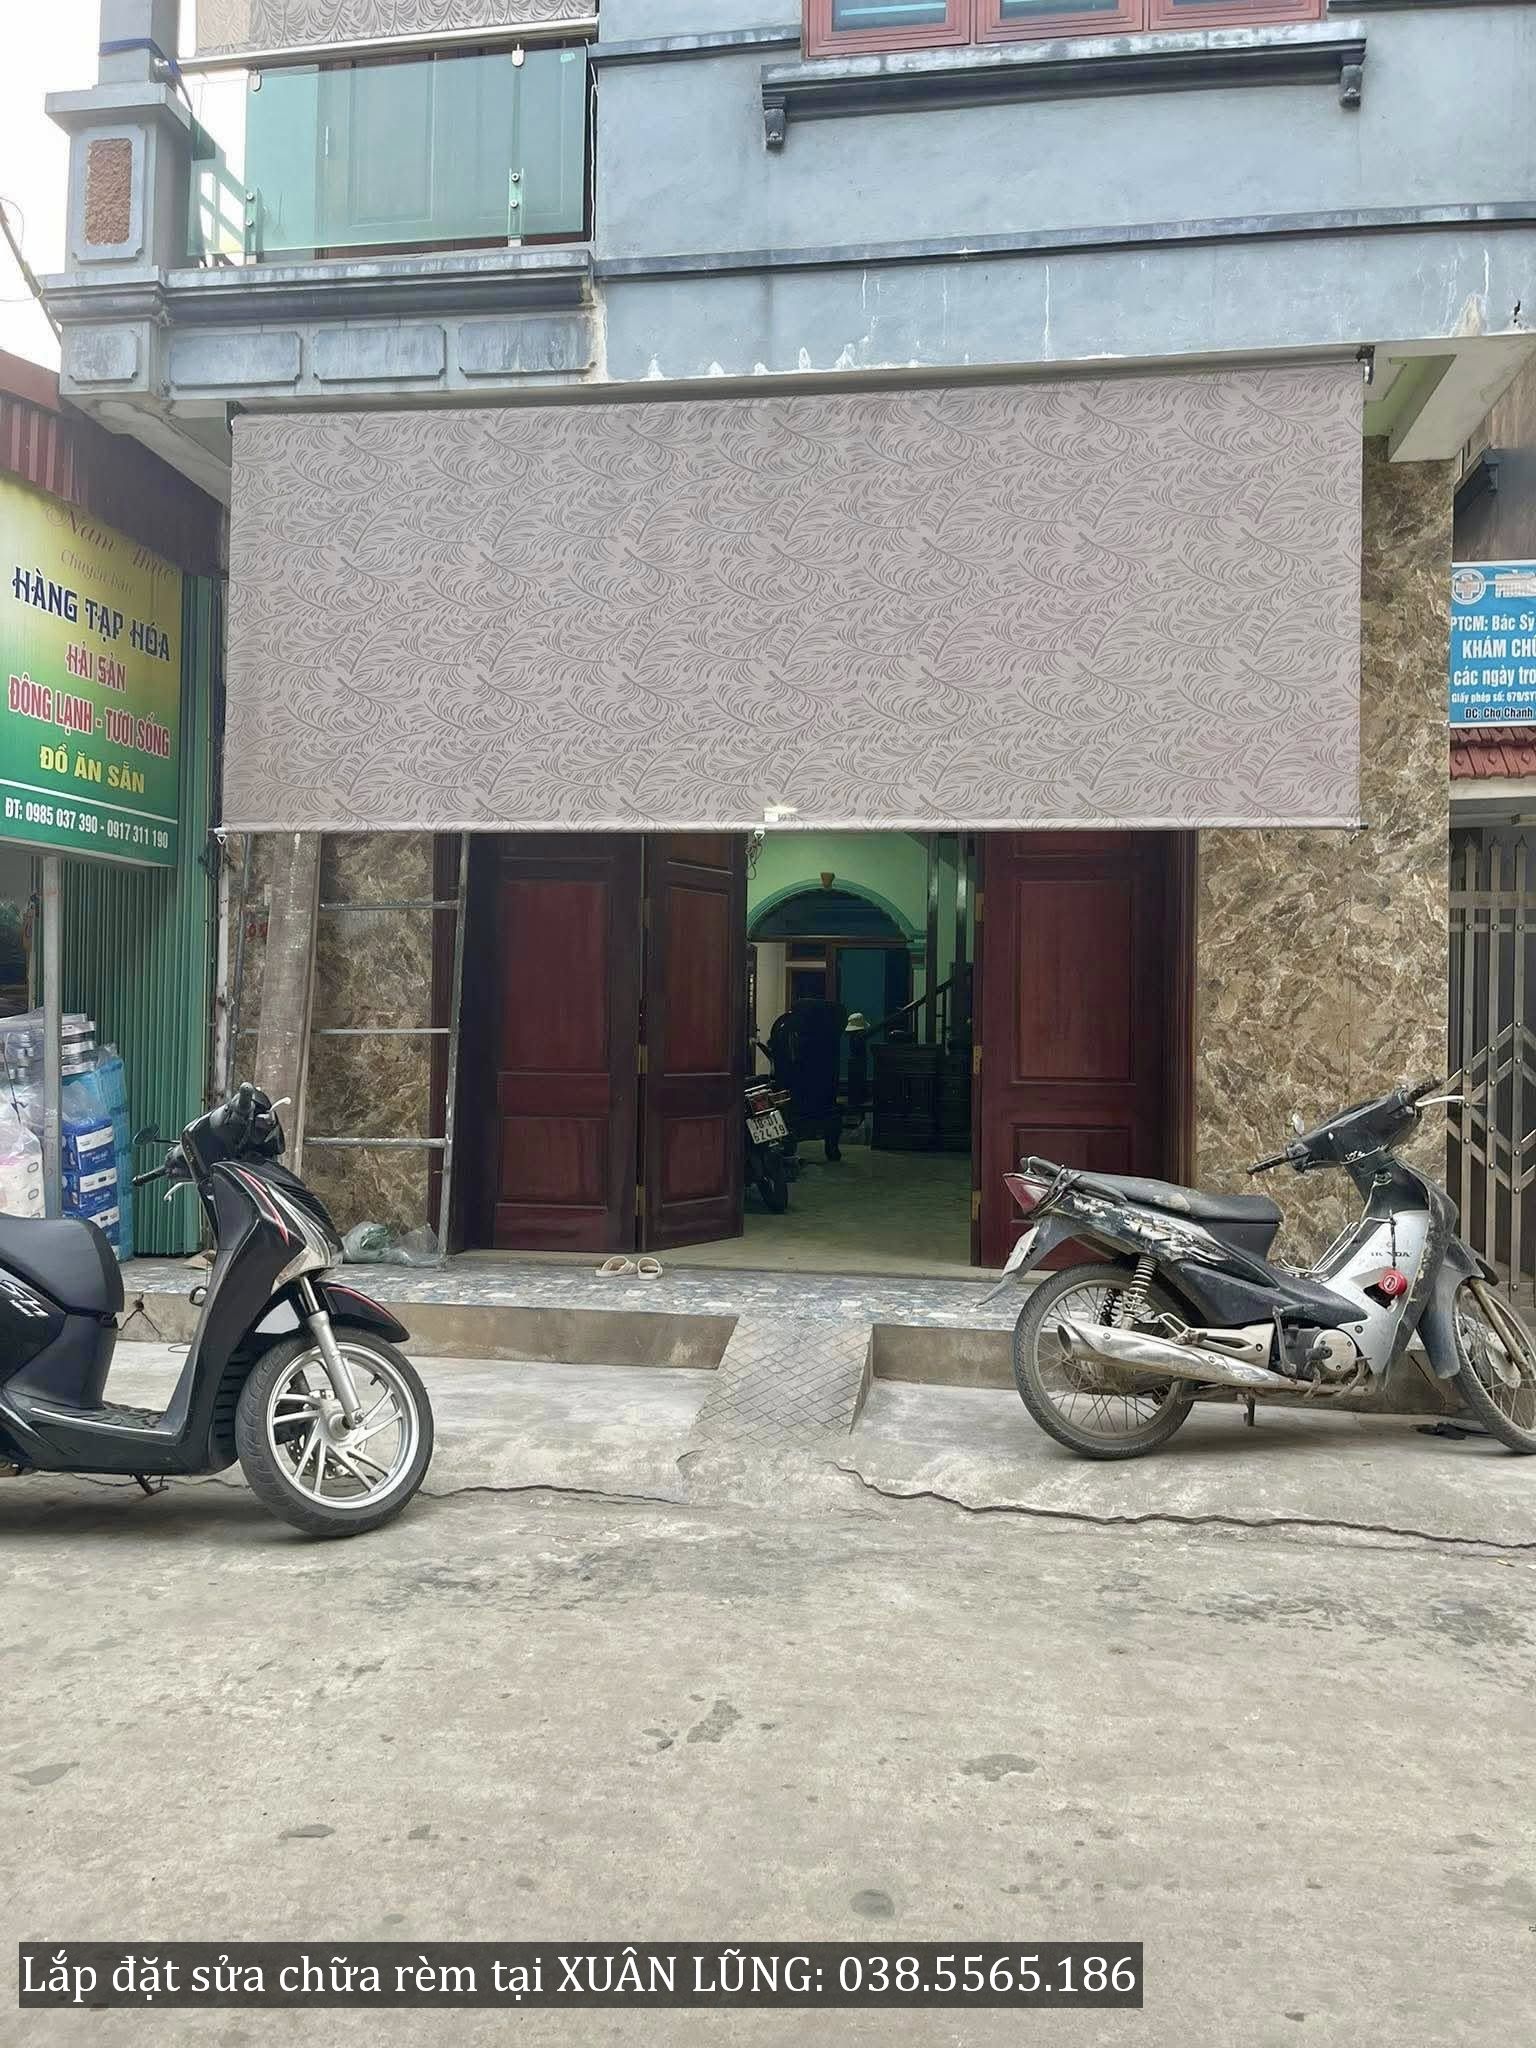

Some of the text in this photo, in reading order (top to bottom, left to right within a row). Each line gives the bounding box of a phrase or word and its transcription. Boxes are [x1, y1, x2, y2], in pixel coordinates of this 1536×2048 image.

[12, 566, 171, 662] HÀNG TẠP HÓA
[1451, 611, 1535, 631] PTCM: Bác Sỹ
[1462, 635, 1507, 659] KHÁM
[66, 641, 127, 693] HẢI SẢN
[1453, 665, 1478, 686] các
[1482, 664, 1515, 687] ngày
[9, 672, 52, 722] ĐÔNG
[55, 690, 94, 735] LẠNH
[105, 707, 134, 748] TƯƠI
[136, 712, 171, 758] SỐNG
[1451, 691, 1470, 704] Giấy
[1470, 691, 1491, 704] phép
[1492, 690, 1505, 702] số:
[1465, 706, 1533, 720] ĐC: Chợ Chanh
[40, 743, 145, 794] ĐỒ ĂN SẴN
[5, 797, 23, 820] ĐT:
[25, 801, 54, 826] 0985
[56, 808, 76, 829] 037
[78, 813, 98, 834] 390
[106, 819, 130, 841] 0917
[132, 826, 149, 845] 311
[152, 830, 168, 849] 190
